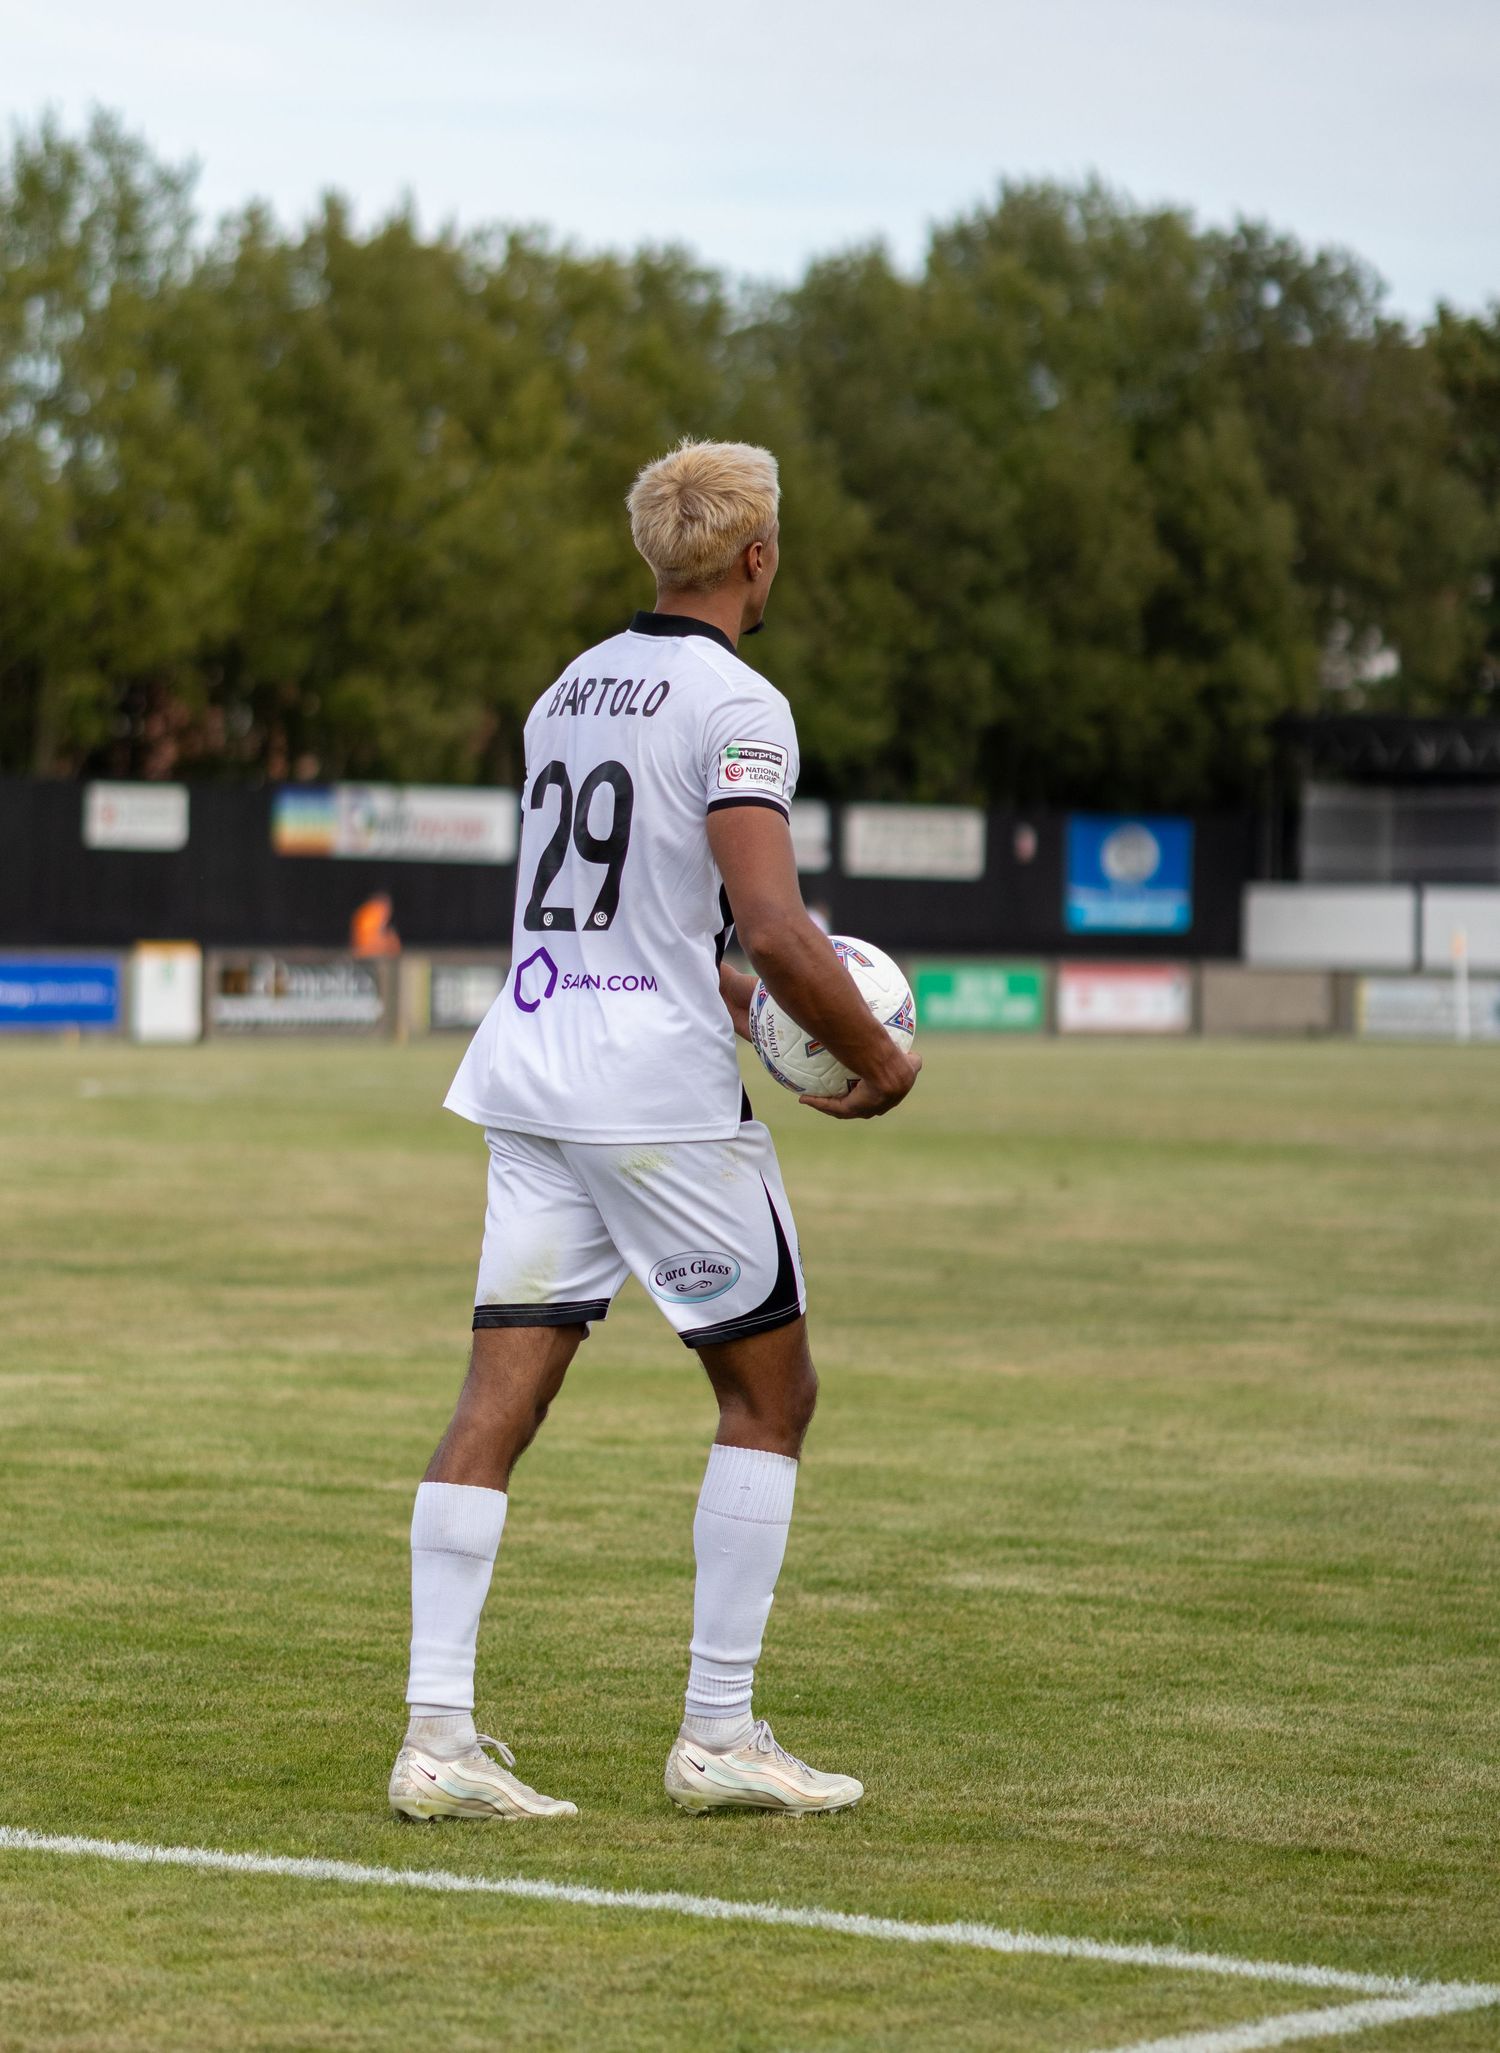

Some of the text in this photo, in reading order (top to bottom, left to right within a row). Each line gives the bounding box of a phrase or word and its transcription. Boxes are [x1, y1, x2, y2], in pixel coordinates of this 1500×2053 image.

[547, 677, 670, 718] BARTOLO
[745, 766, 780, 779] NATIONAL
[749, 774, 777, 784] LEAGUE
[523, 760, 634, 932] 29
[768, 1013, 780, 1058] ULTIMAX
[655, 1260, 732, 1287] Cara Glass
